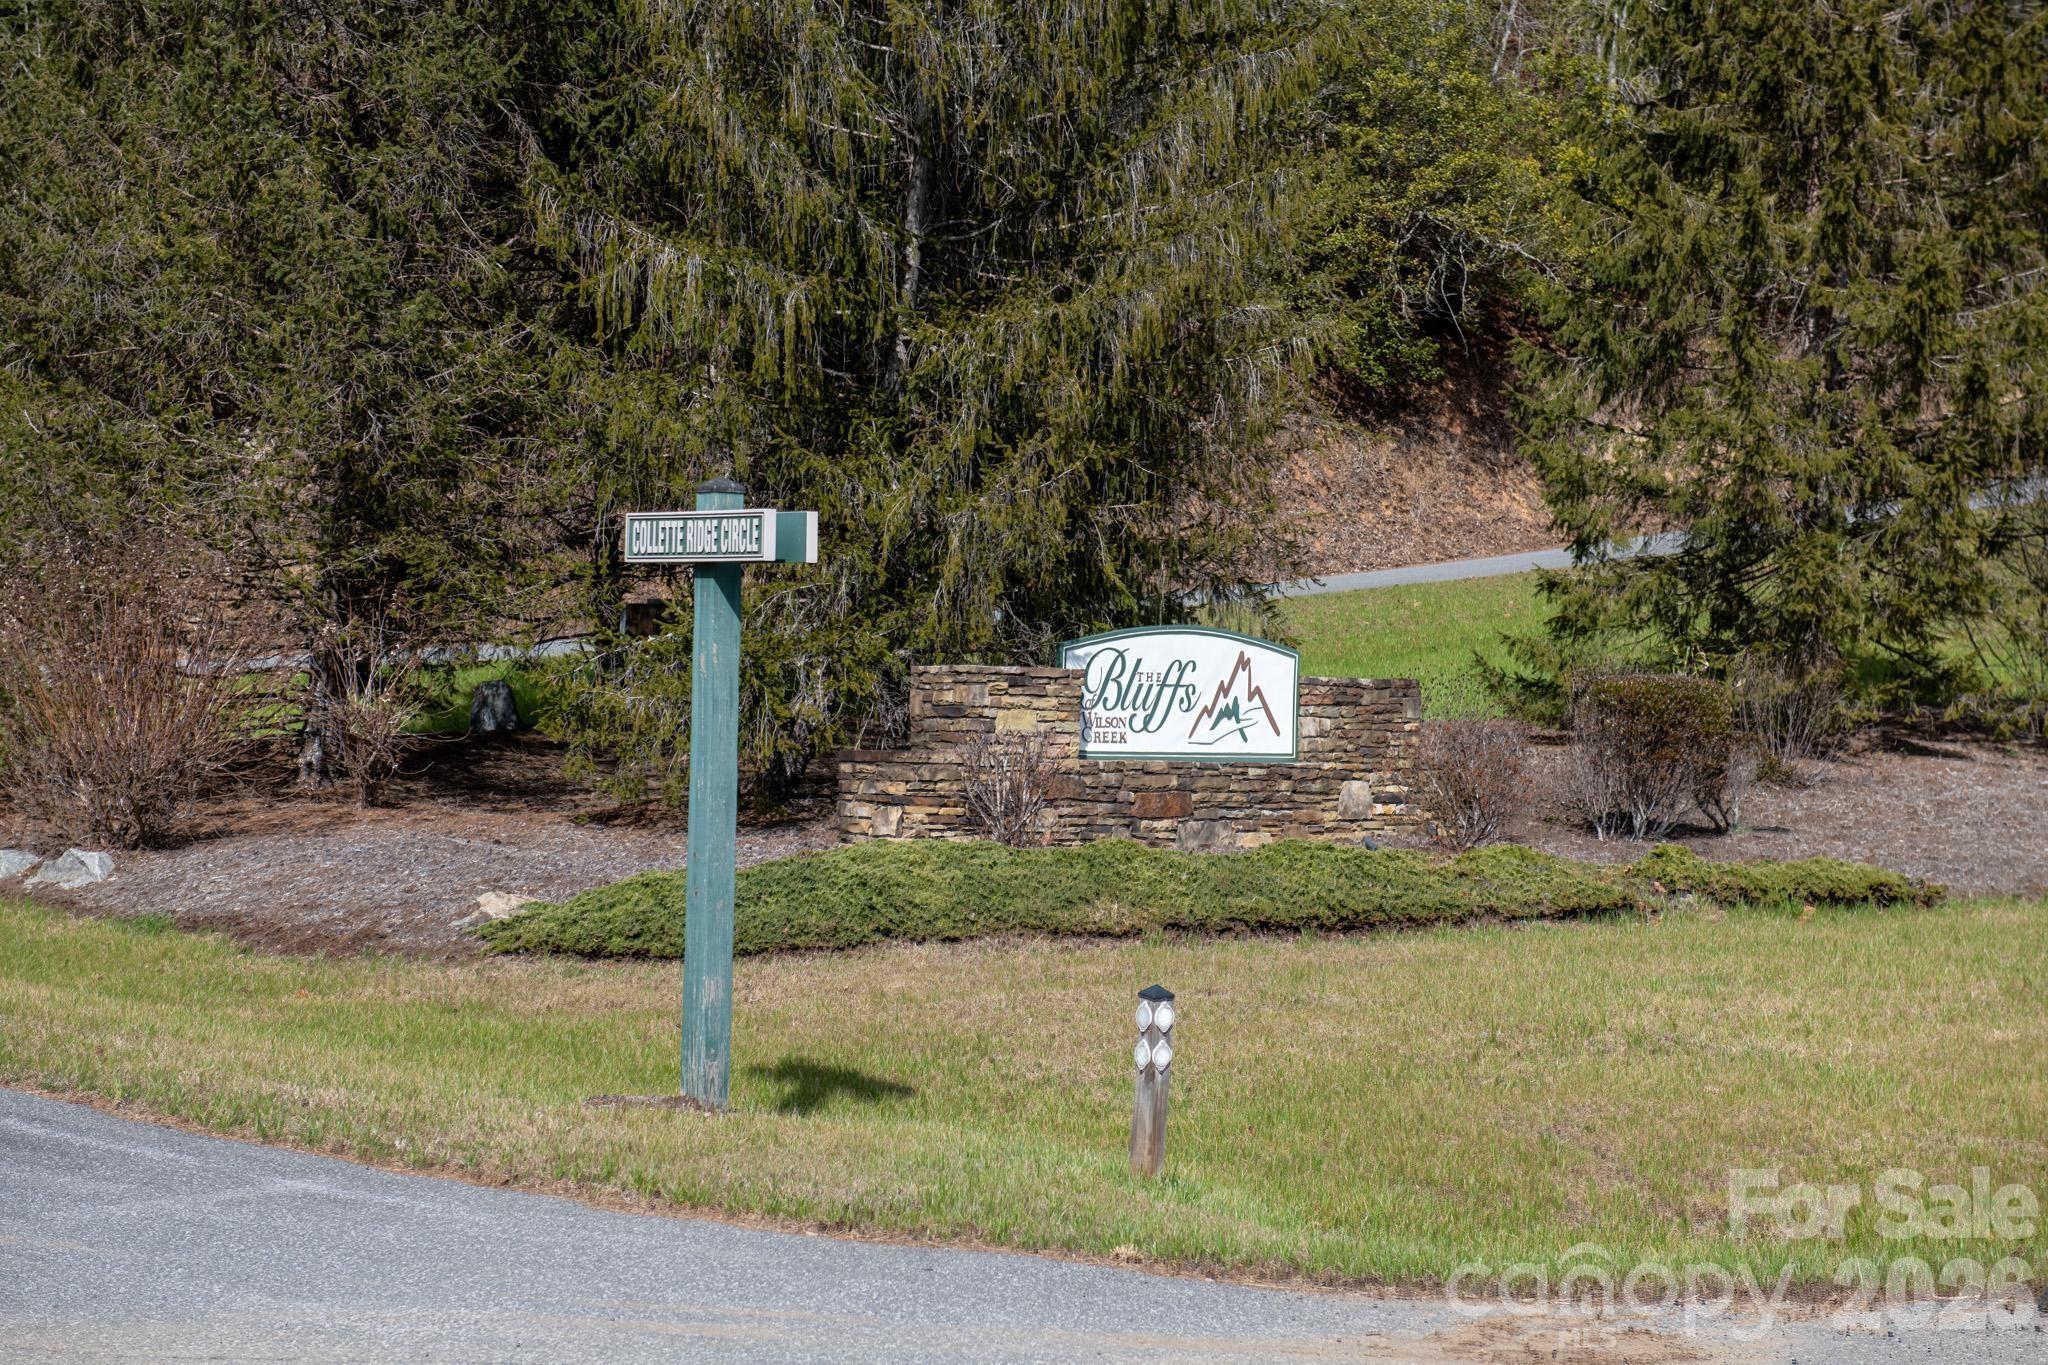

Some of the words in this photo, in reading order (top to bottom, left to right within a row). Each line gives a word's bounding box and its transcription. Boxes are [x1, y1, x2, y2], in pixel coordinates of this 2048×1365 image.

[632, 520, 684, 555] COLLETTE
[686, 519, 718, 553] RIDGE
[720, 518, 760, 553] CIRCLE
[1081, 647, 1202, 733] Bluffs
[1137, 671, 1162, 683] THE
[1081, 727, 1128, 744] CREEK
